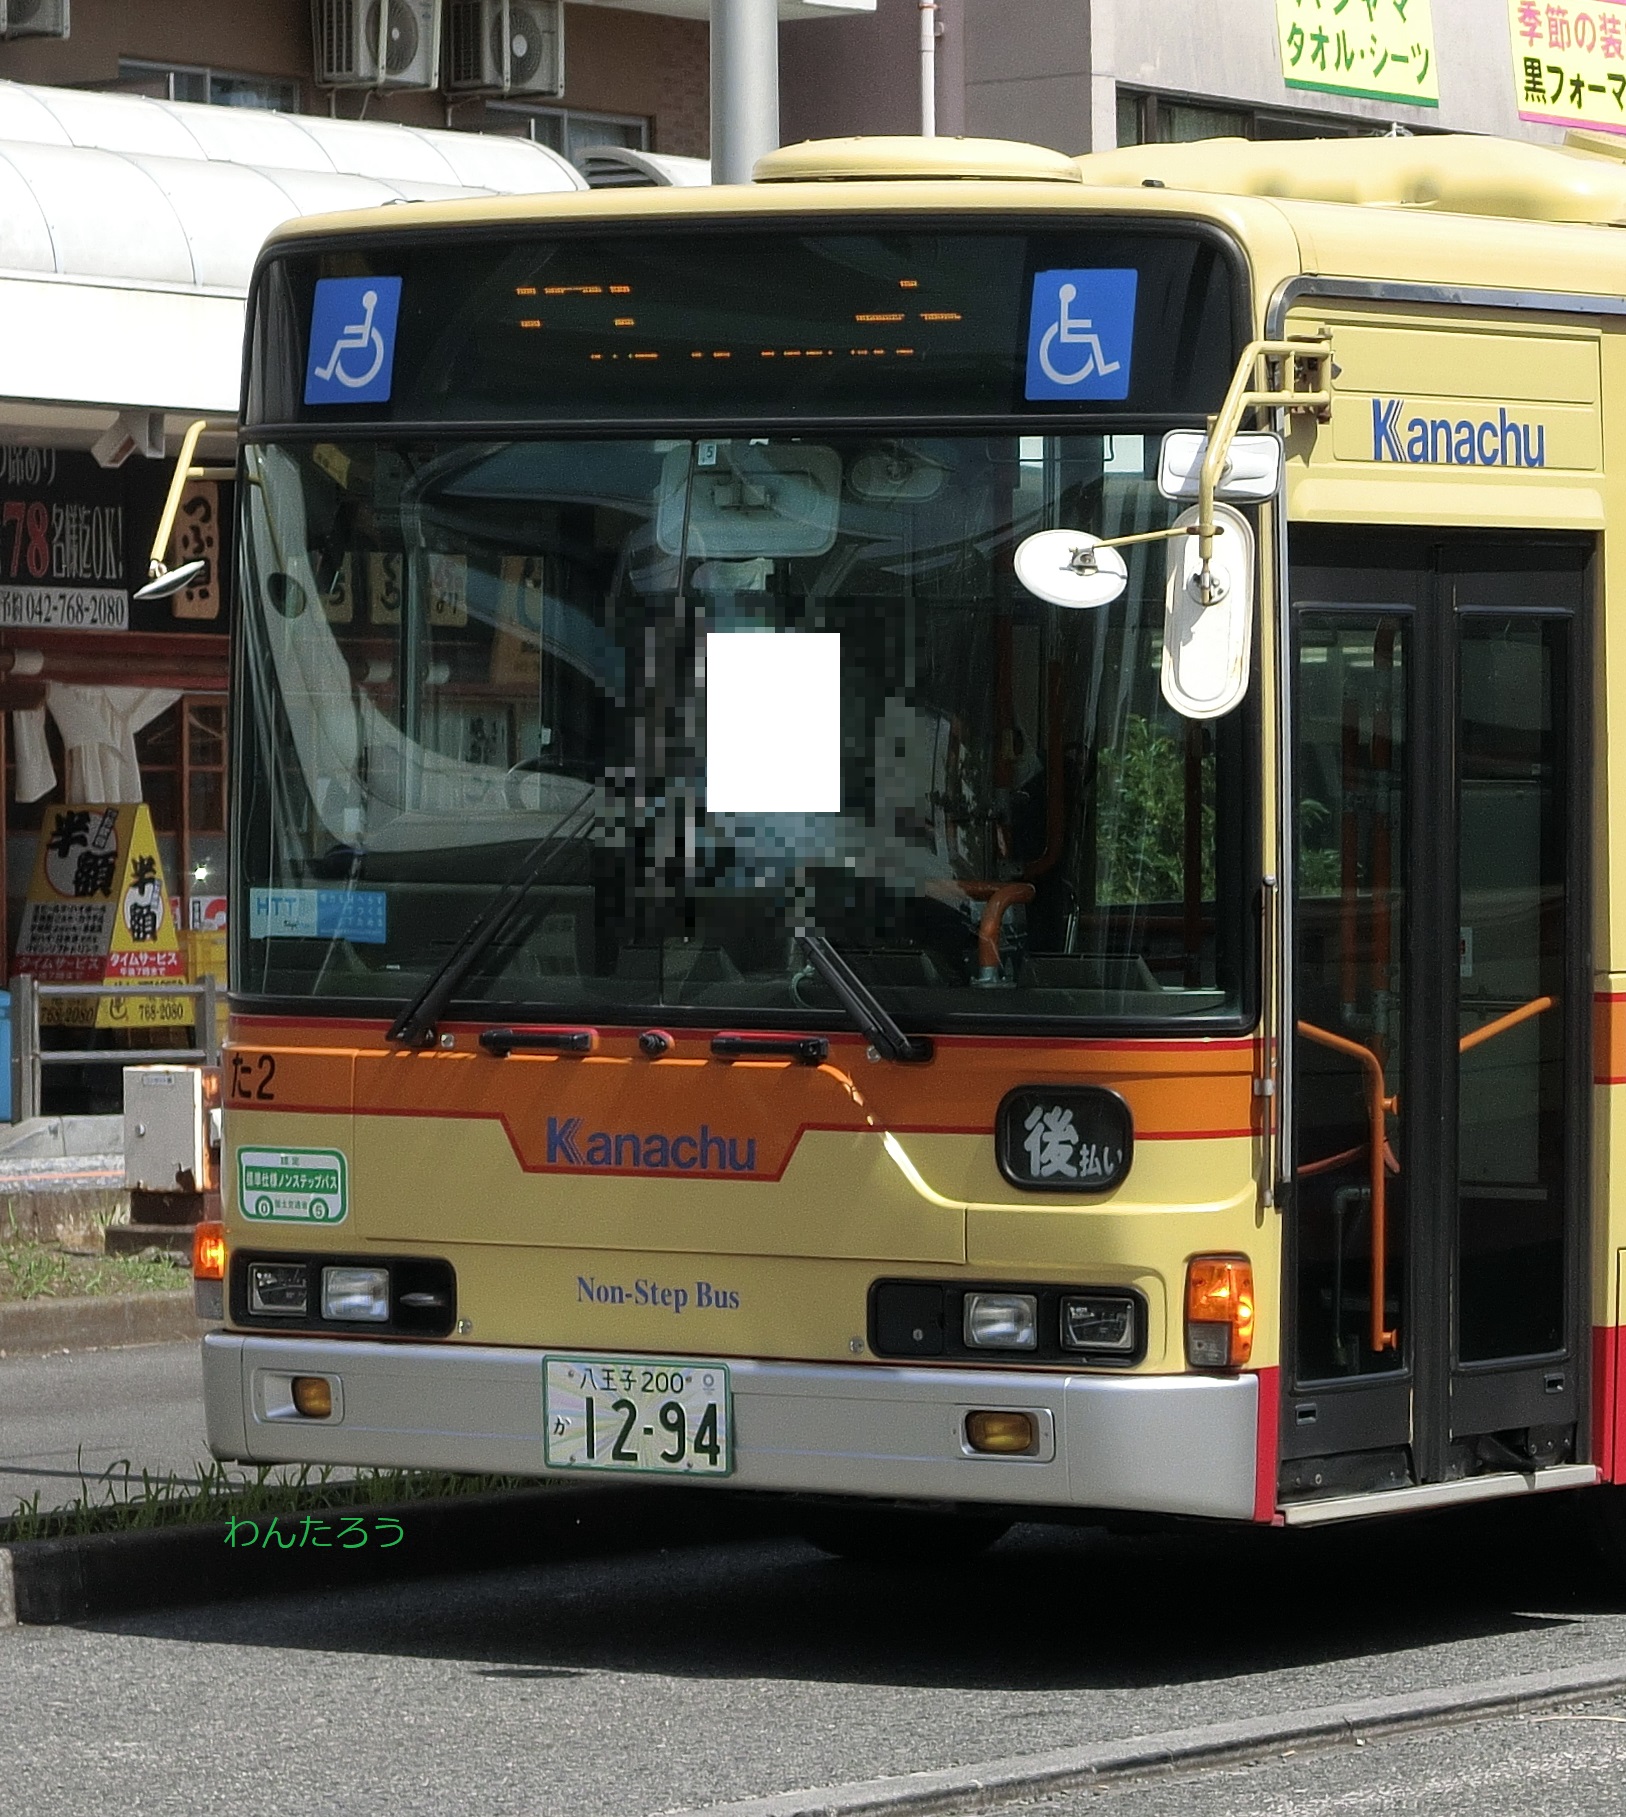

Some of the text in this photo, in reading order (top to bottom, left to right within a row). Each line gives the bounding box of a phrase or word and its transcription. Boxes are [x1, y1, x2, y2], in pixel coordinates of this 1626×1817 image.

[1287, 22, 1429, 84] タオル・シーツ
[1373, 398, 1544, 468] Kanachu
[110, 952, 178, 966] タイムサービス
[138, 1003, 184, 1020] 768-2080
[232, 1053, 276, 1100] た2
[546, 1116, 757, 1171] Kanachu
[1024, 1105, 1123, 1178] 後払い
[577, 1276, 740, 1313] Non-Step Bus
[552, 1416, 572, 1437] か
[584, 1396, 720, 1466] 12-94
